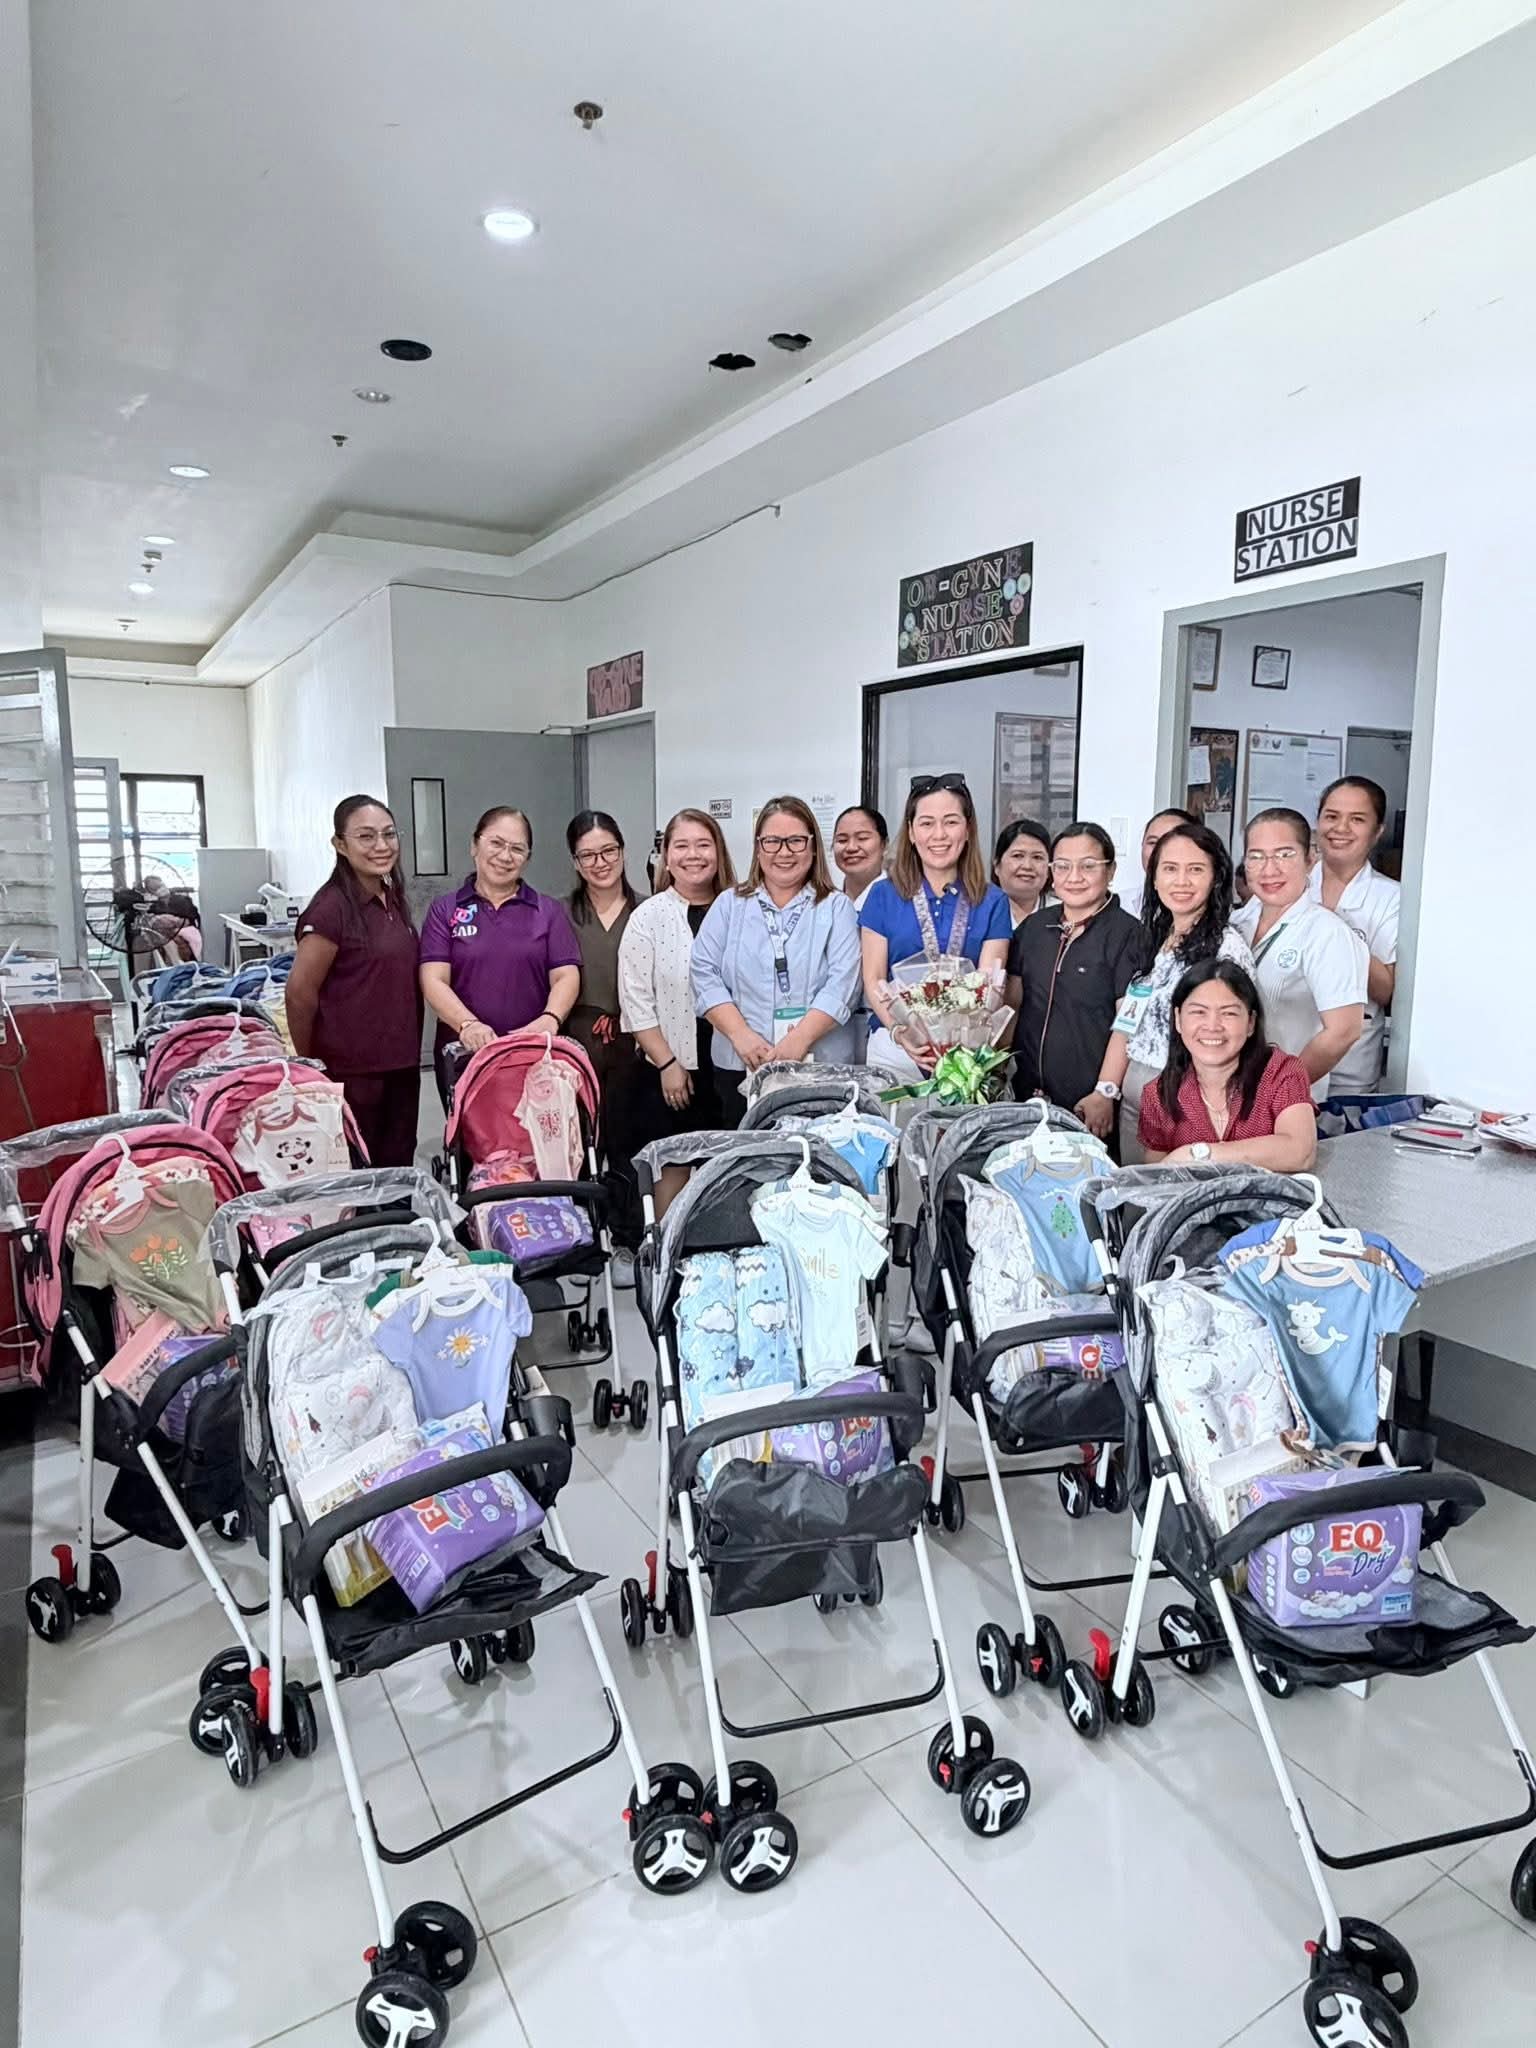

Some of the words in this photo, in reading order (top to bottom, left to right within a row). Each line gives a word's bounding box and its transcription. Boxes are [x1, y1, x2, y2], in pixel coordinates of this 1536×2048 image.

[1248, 488, 1342, 539] NURSE
[1237, 518, 1357, 574] STATION
[907, 547, 1022, 608] OB-GYNE
[920, 589, 1004, 635] NURSE
[916, 615, 1017, 662] STATION
[1330, 1521, 1385, 1554] EQ
[1351, 1551, 1389, 1578] Dry
